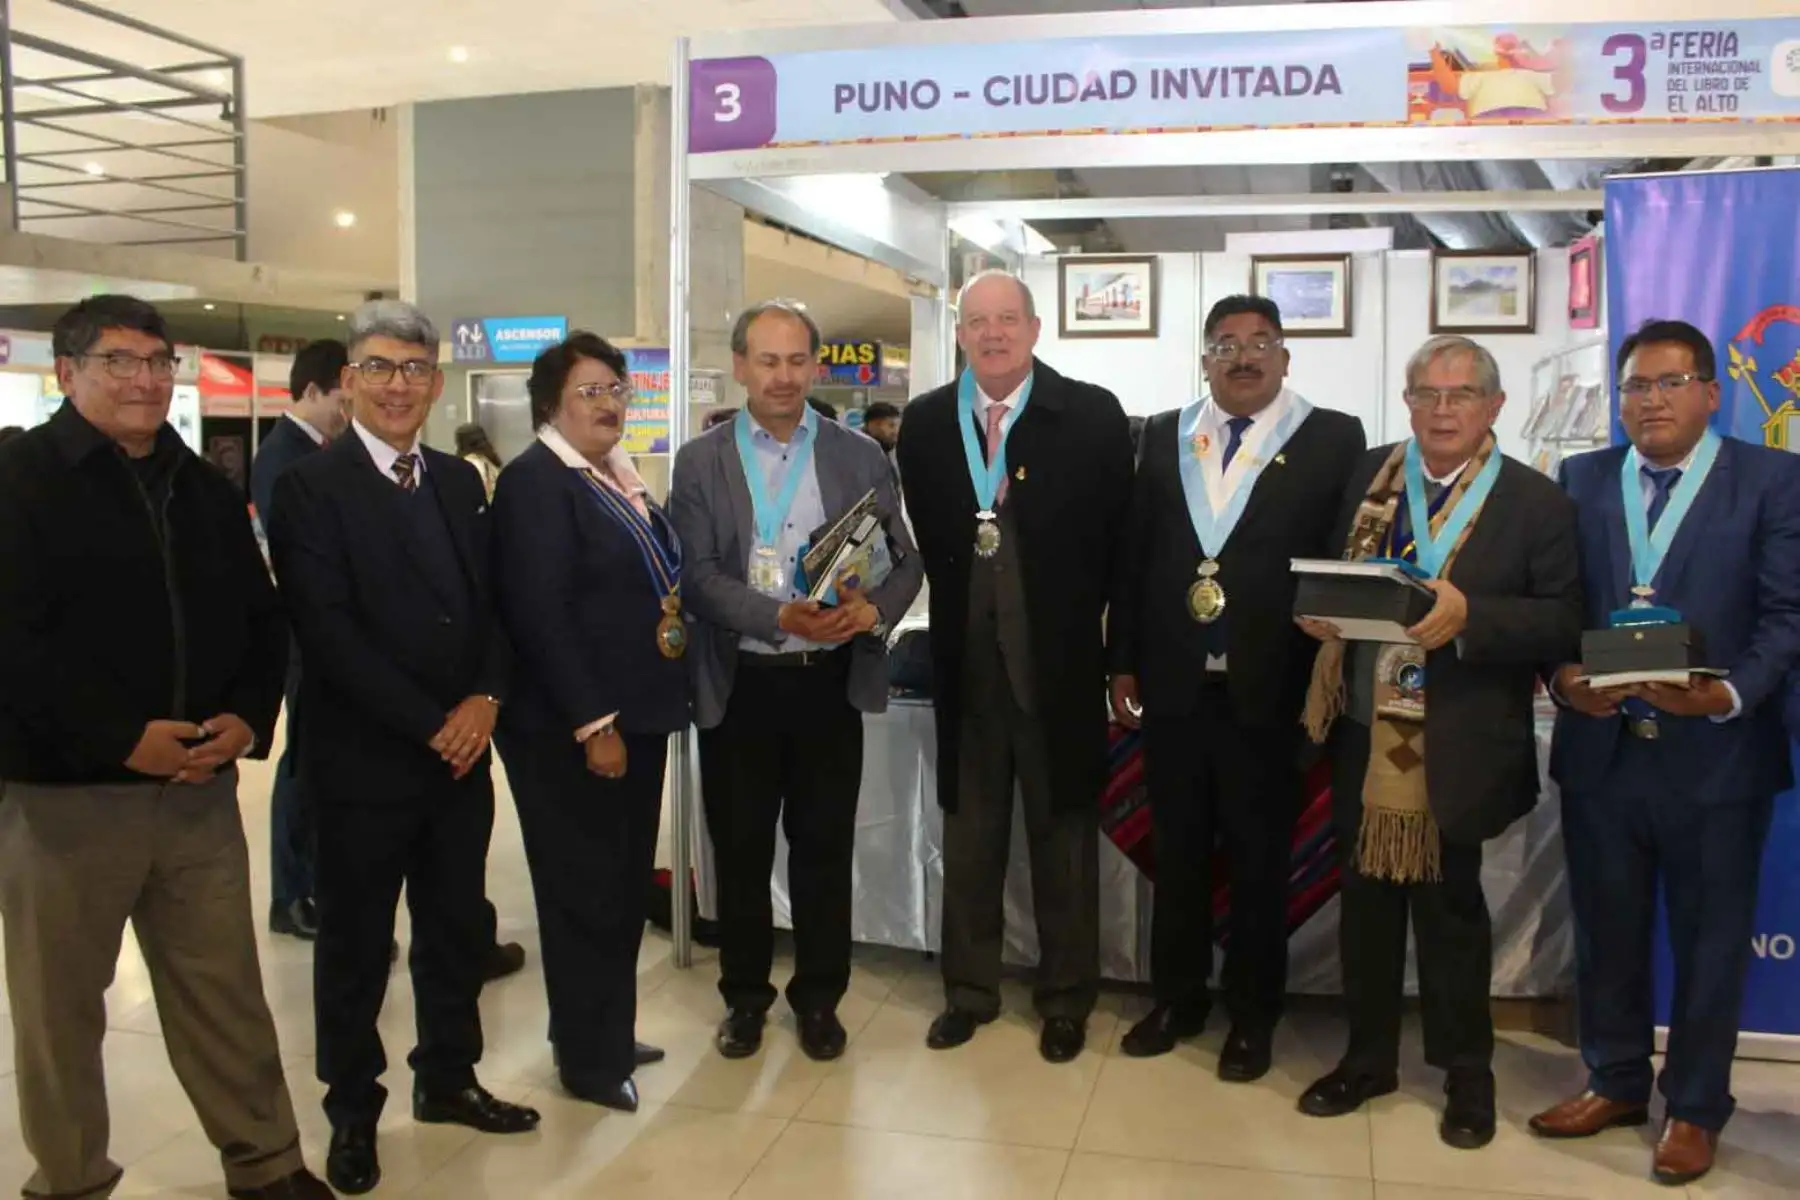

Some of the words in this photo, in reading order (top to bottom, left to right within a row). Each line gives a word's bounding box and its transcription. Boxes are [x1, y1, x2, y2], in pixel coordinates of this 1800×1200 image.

[1668, 31, 1739, 58] FERIA
[1667, 60, 1762, 76] INTERNACIONAL
[834, 79, 941, 114] PUNO
[983, 69, 1138, 106] CIUDAD
[1150, 64, 1343, 100] INVITADA
[1667, 78, 1689, 92] DEL
[1694, 77, 1729, 91] LIBRO
[1733, 77, 1750, 91] DE
[714, 82, 742, 122] 3
[1667, 95, 1688, 112] EL
[1695, 94, 1739, 112] ALTO
[495, 327, 562, 342] ASCENSOR
